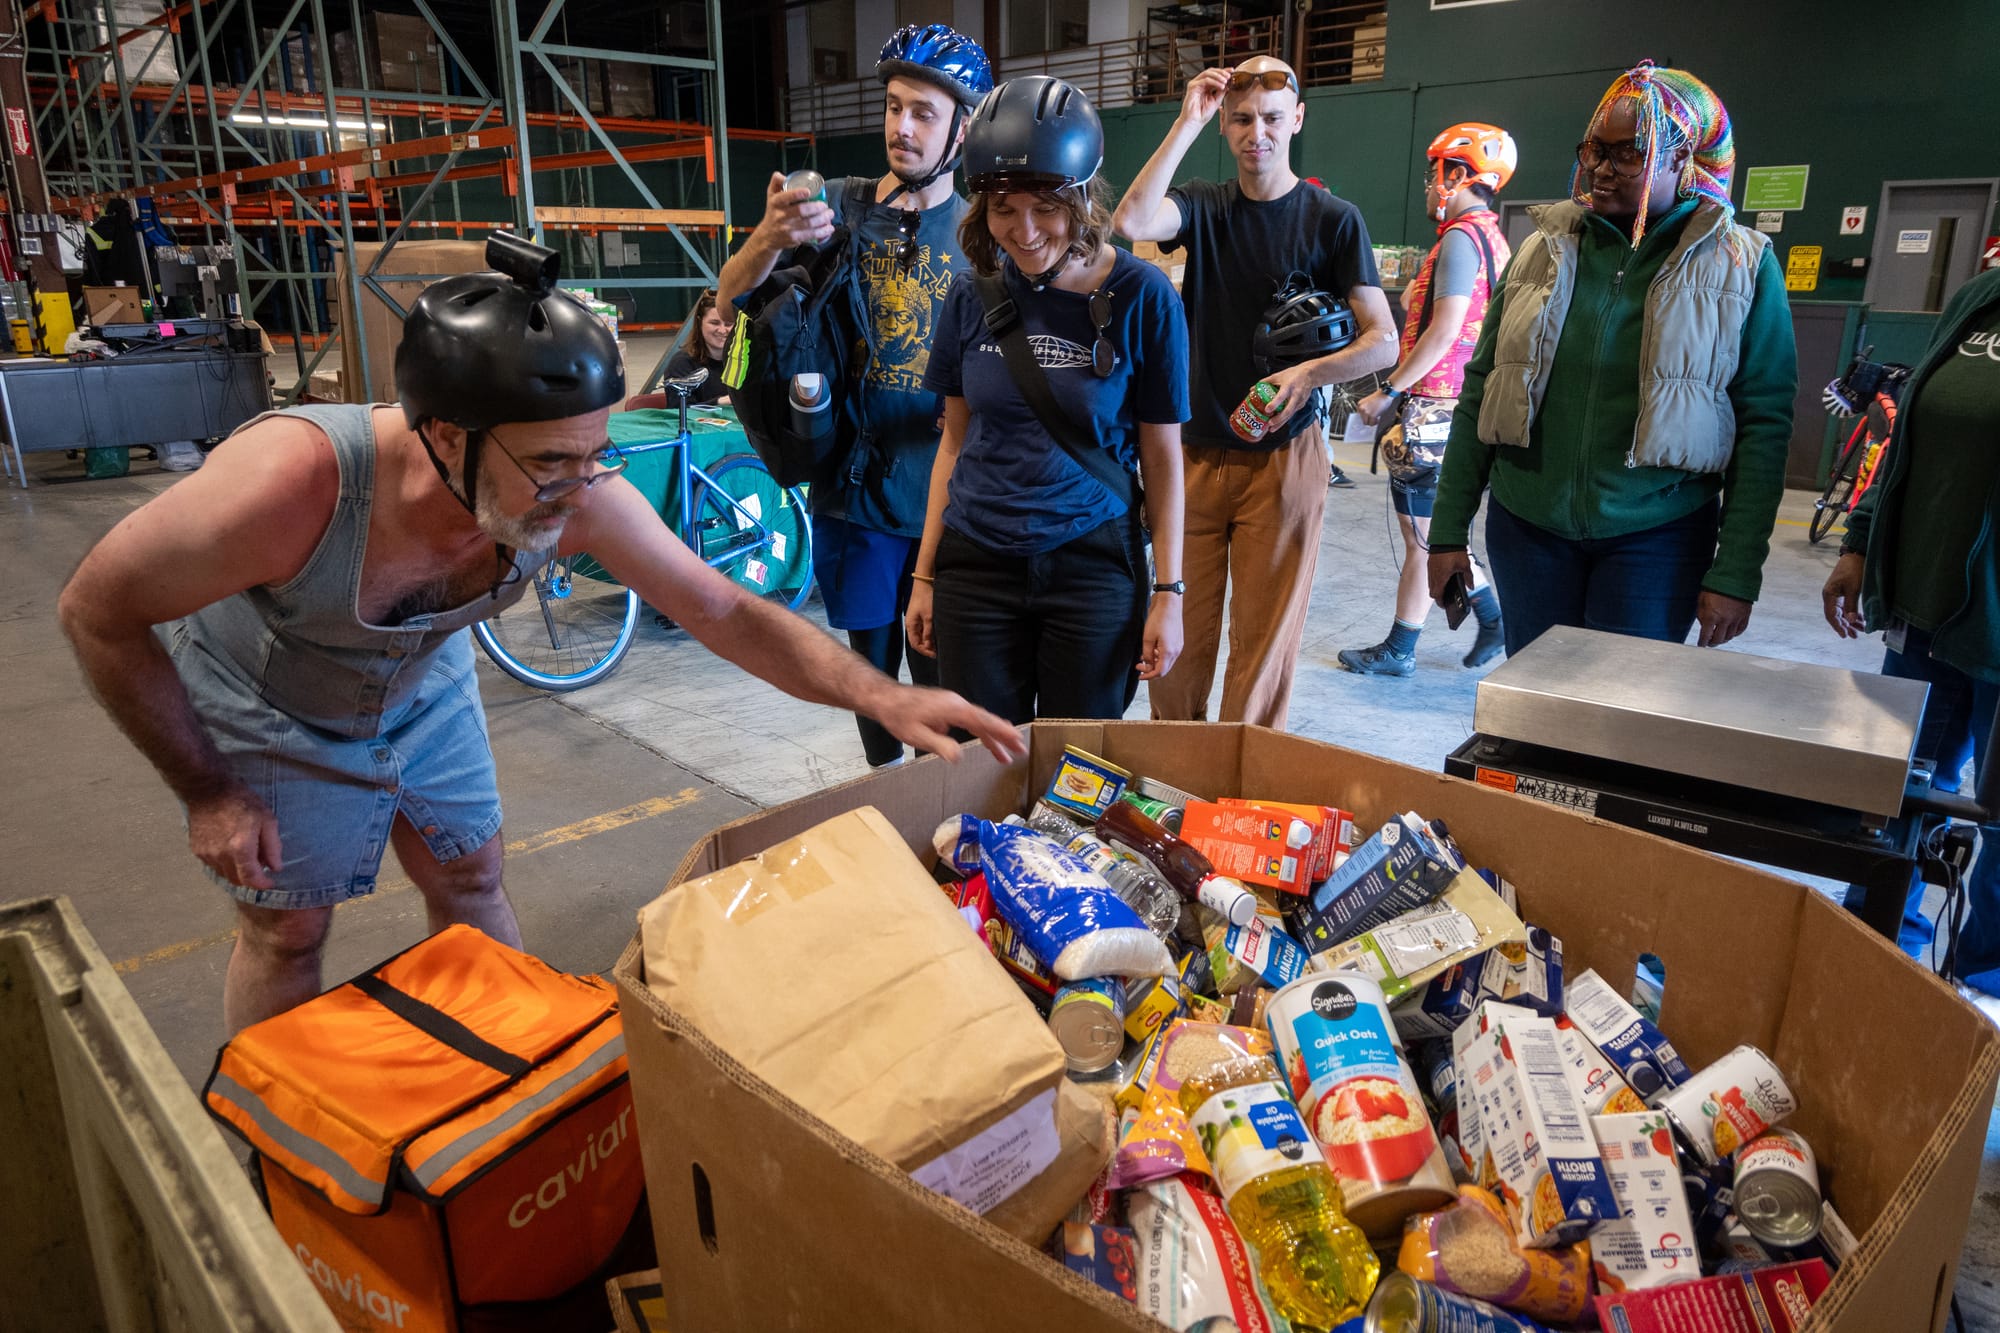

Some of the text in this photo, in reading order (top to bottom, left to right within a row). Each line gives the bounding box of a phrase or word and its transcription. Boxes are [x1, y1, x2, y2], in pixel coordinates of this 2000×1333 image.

[1315, 1029, 1378, 1049] Quick Oats
[1608, 1022, 1642, 1048] BROTH
[1265, 1106, 1278, 1115] Oil
[1256, 1112, 1296, 1126] Vegetable
[508, 1104, 632, 1230] caviar
[1556, 1161, 1596, 1173] BROTH
[1562, 1173, 1596, 1182] CHICKEN
[1202, 1193, 1226, 1223] RICE
[1652, 1247, 1692, 1258] SWANSON
[1150, 1253, 1161, 1266] 20
[1616, 1263, 1647, 1271] ELEVATE
[296, 1243, 411, 1329] caviar
